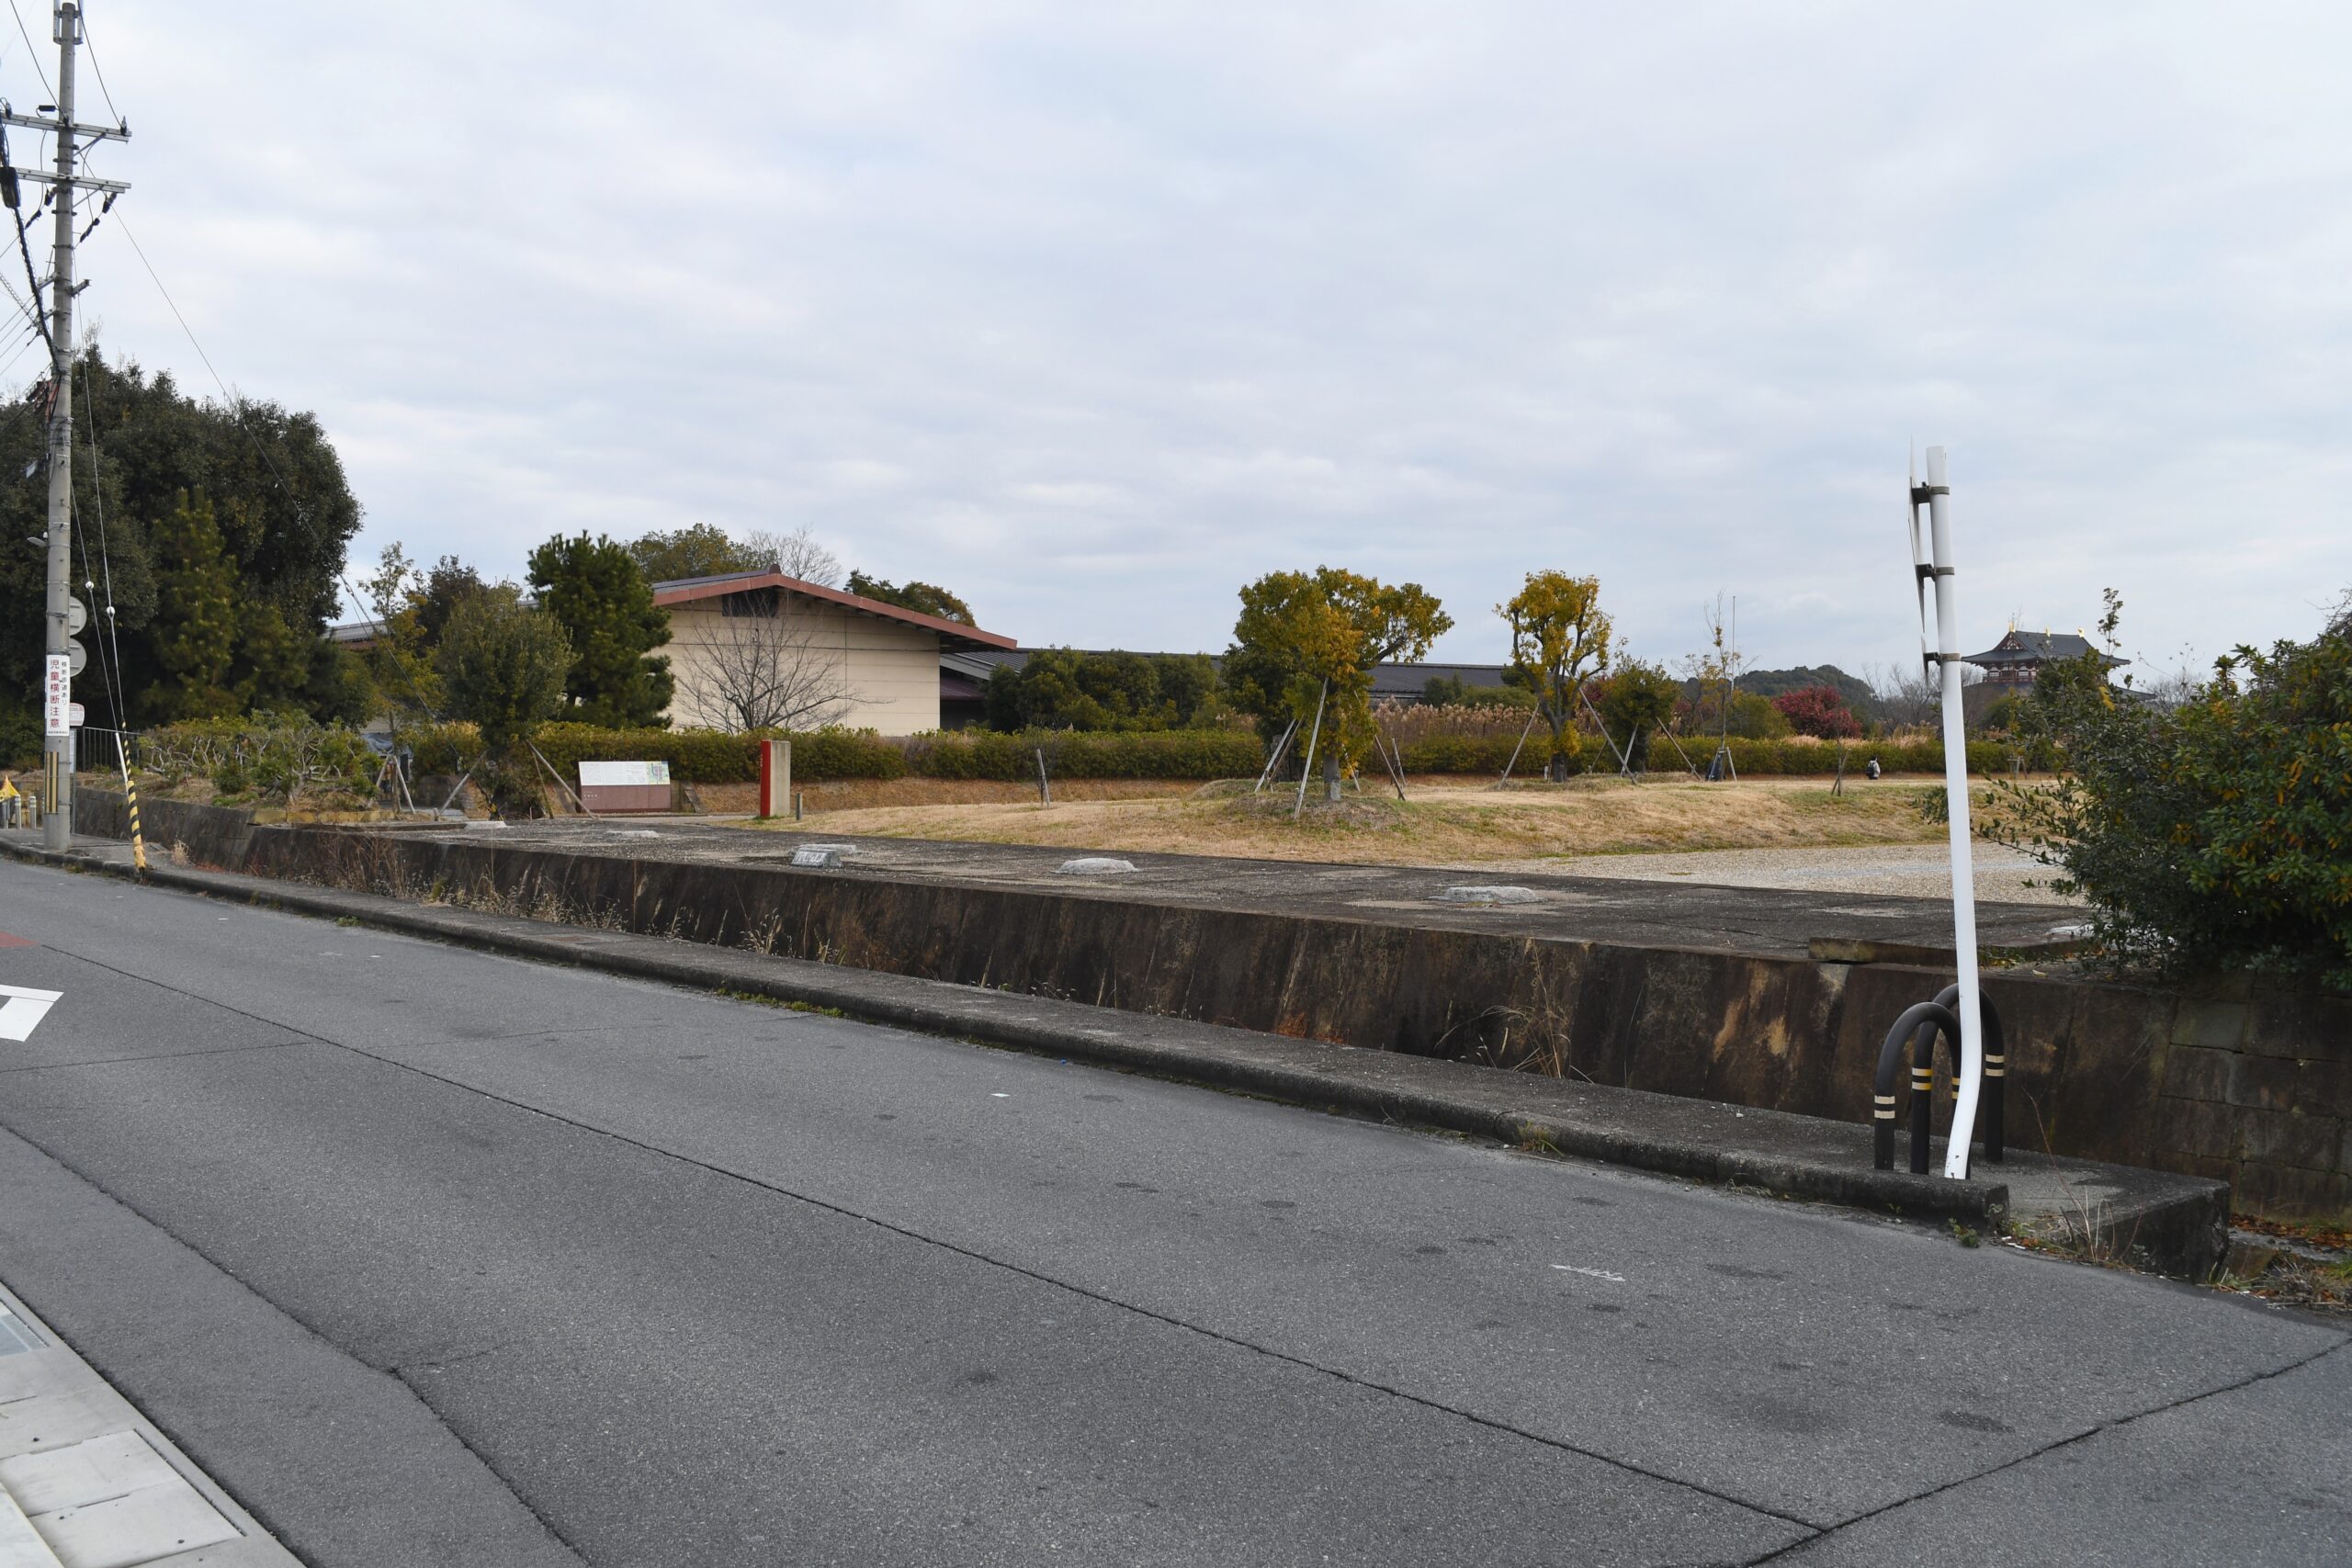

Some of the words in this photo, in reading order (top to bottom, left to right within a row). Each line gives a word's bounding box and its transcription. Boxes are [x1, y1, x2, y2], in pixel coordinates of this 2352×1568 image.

[50, 660, 60, 728] 児童横断注意
